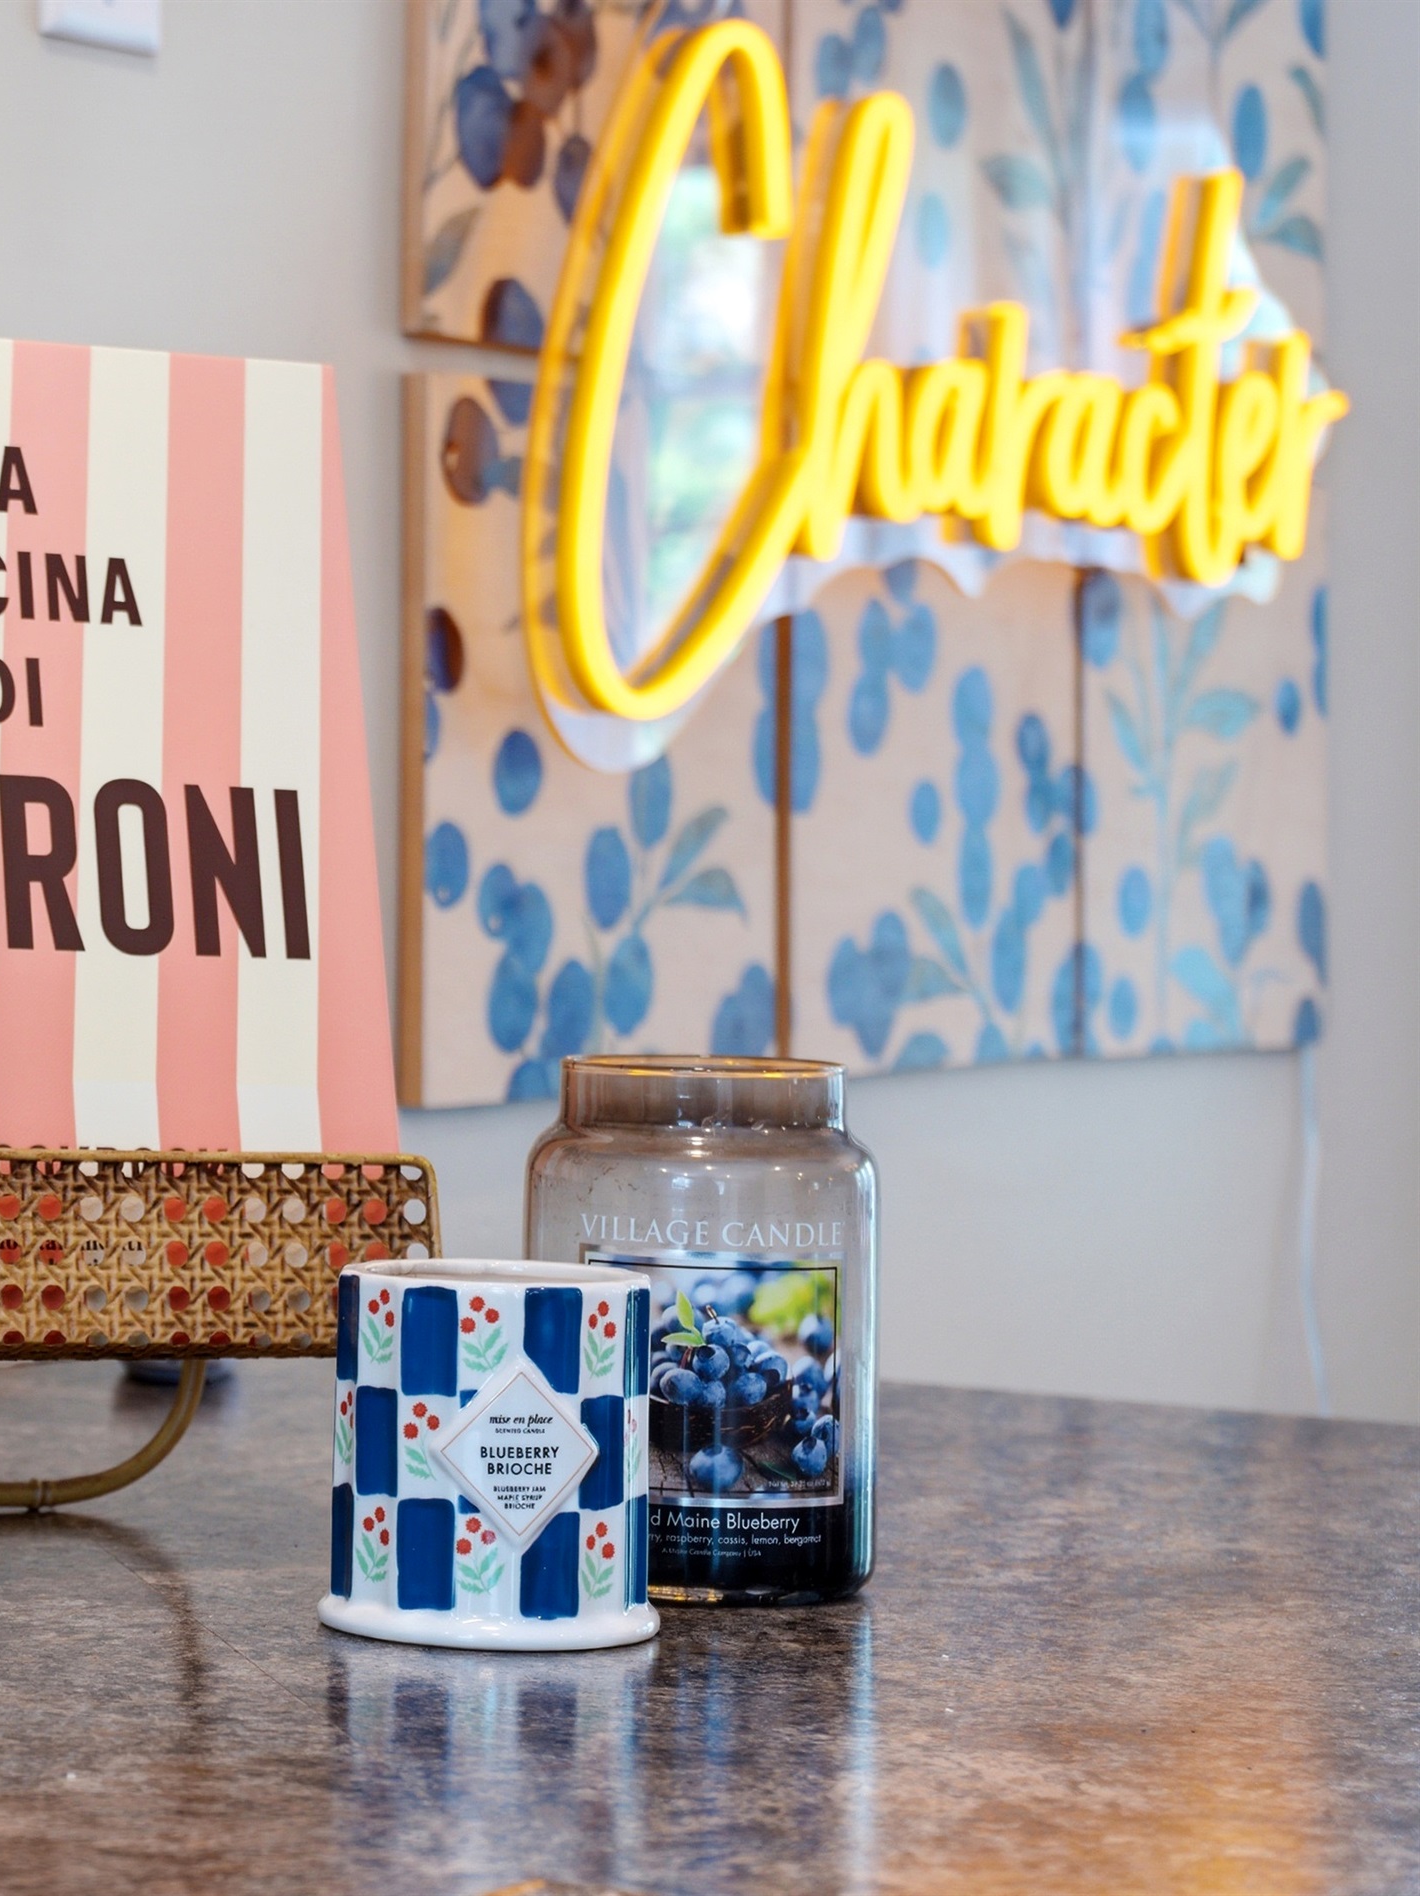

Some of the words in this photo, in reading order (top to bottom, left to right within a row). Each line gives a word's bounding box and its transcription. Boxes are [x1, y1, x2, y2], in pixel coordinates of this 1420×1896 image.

[542, 17, 1350, 722] Character
[580, 1213, 709, 1245] VILLAGE
[721, 1221, 842, 1248] CANDLE
[513, 1416, 525, 1424] en
[527, 1413, 553, 1427] place
[480, 1446, 559, 1459] BLUEBERRY
[487, 1462, 552, 1476] BRIOCHE
[667, 1511, 720, 1528] Maine
[726, 1512, 800, 1533] Blueberry
[665, 1533, 714, 1546] raspberry,
[718, 1536, 748, 1546] cassis,
[751, 1533, 781, 1546] lemon,
[783, 1533, 822, 1547] bergamot
